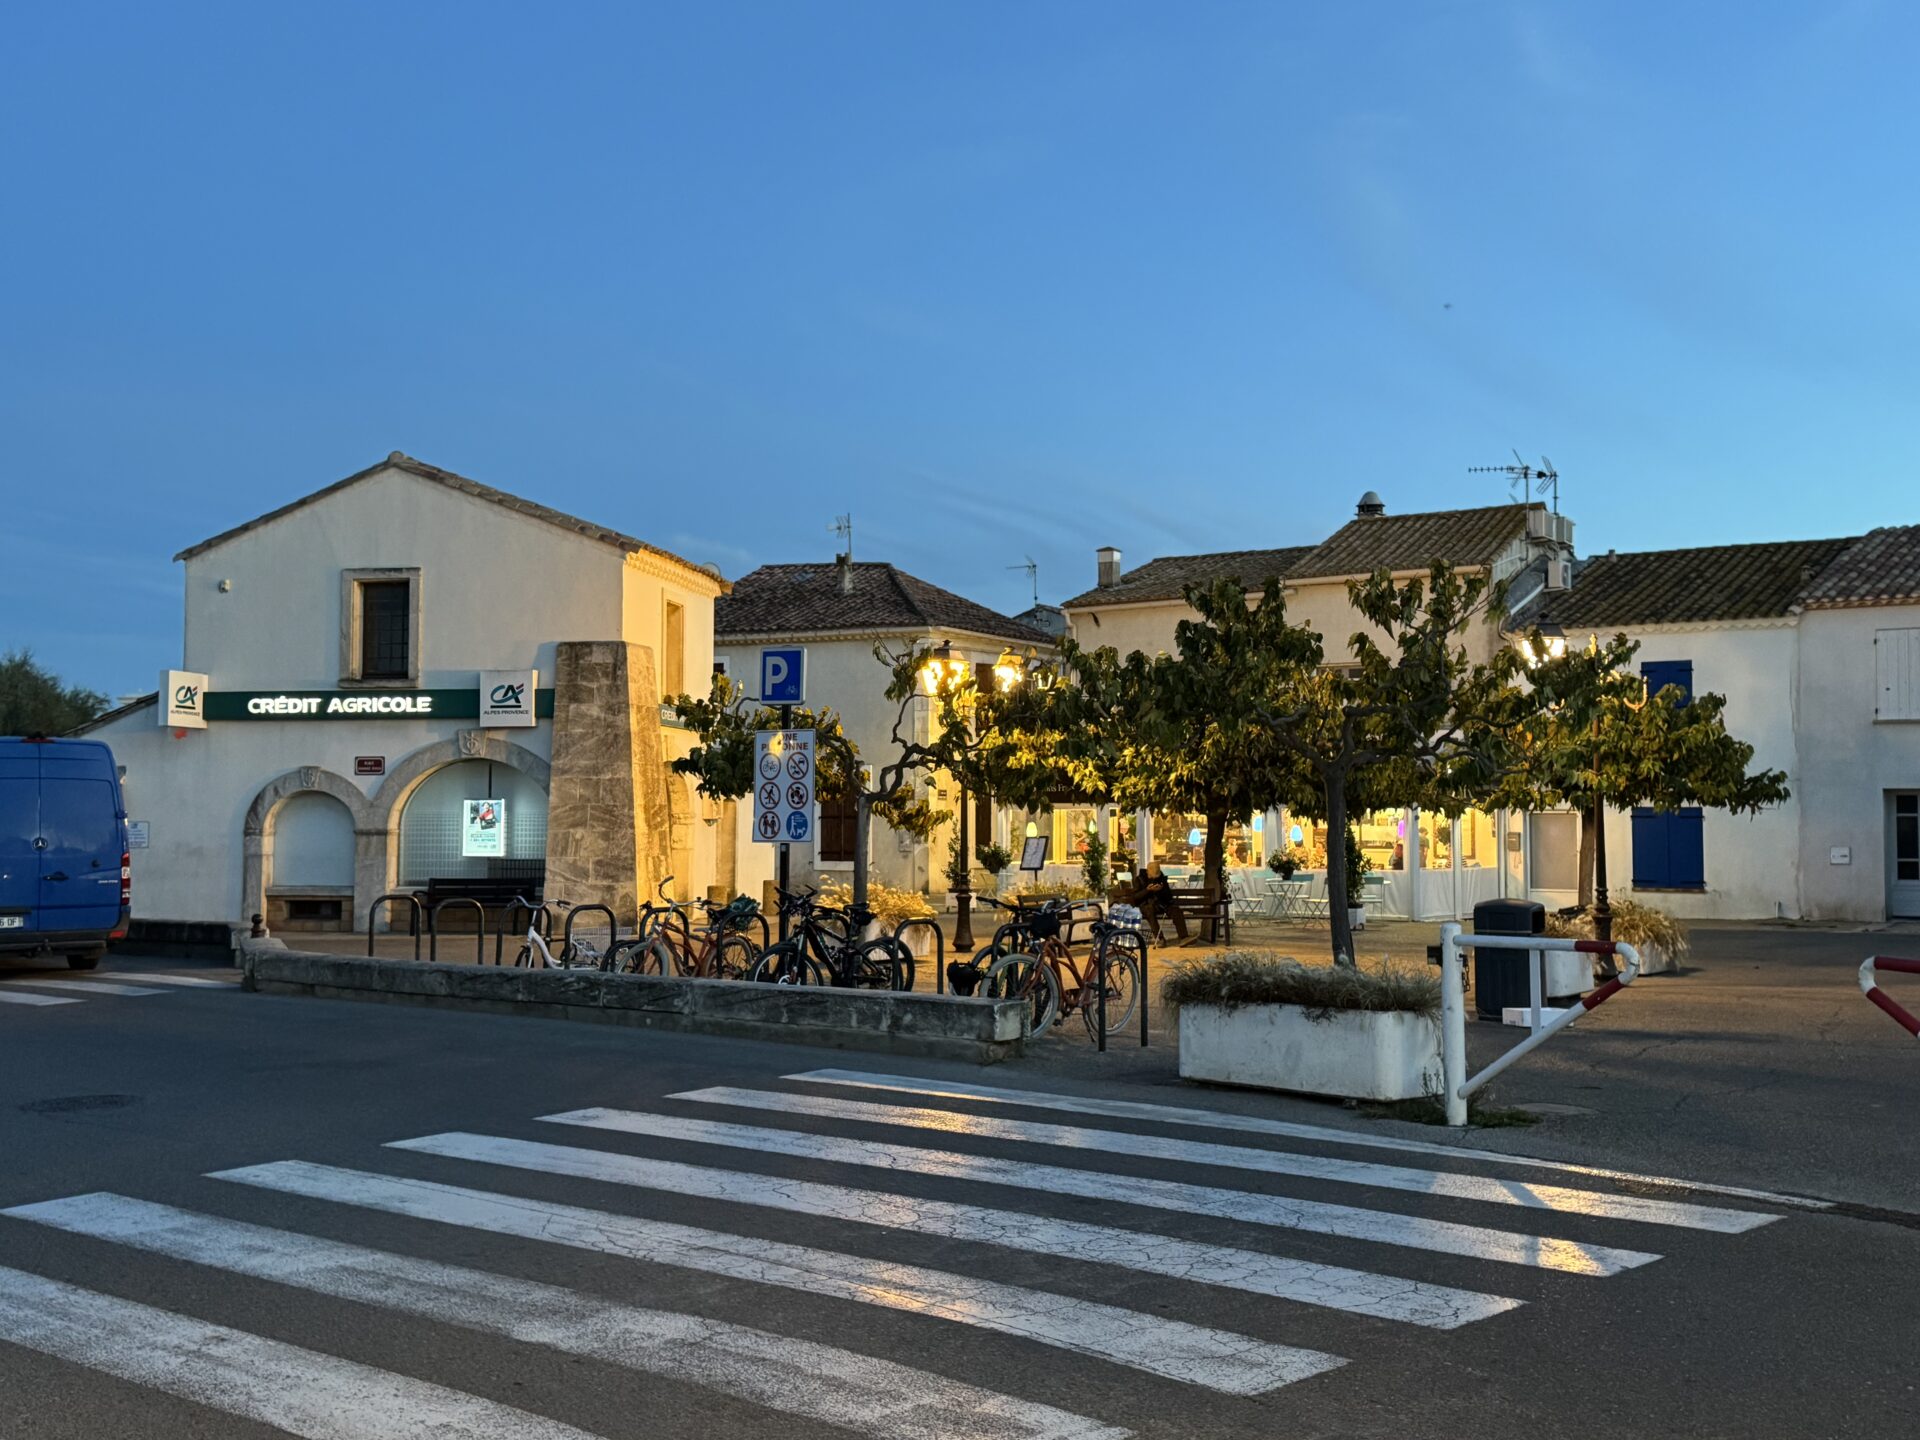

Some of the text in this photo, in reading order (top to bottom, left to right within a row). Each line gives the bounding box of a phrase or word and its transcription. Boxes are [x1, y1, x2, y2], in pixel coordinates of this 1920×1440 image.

[765, 656, 788, 695] P
[248, 695, 432, 714] CRÉDIT AGRICOLE
